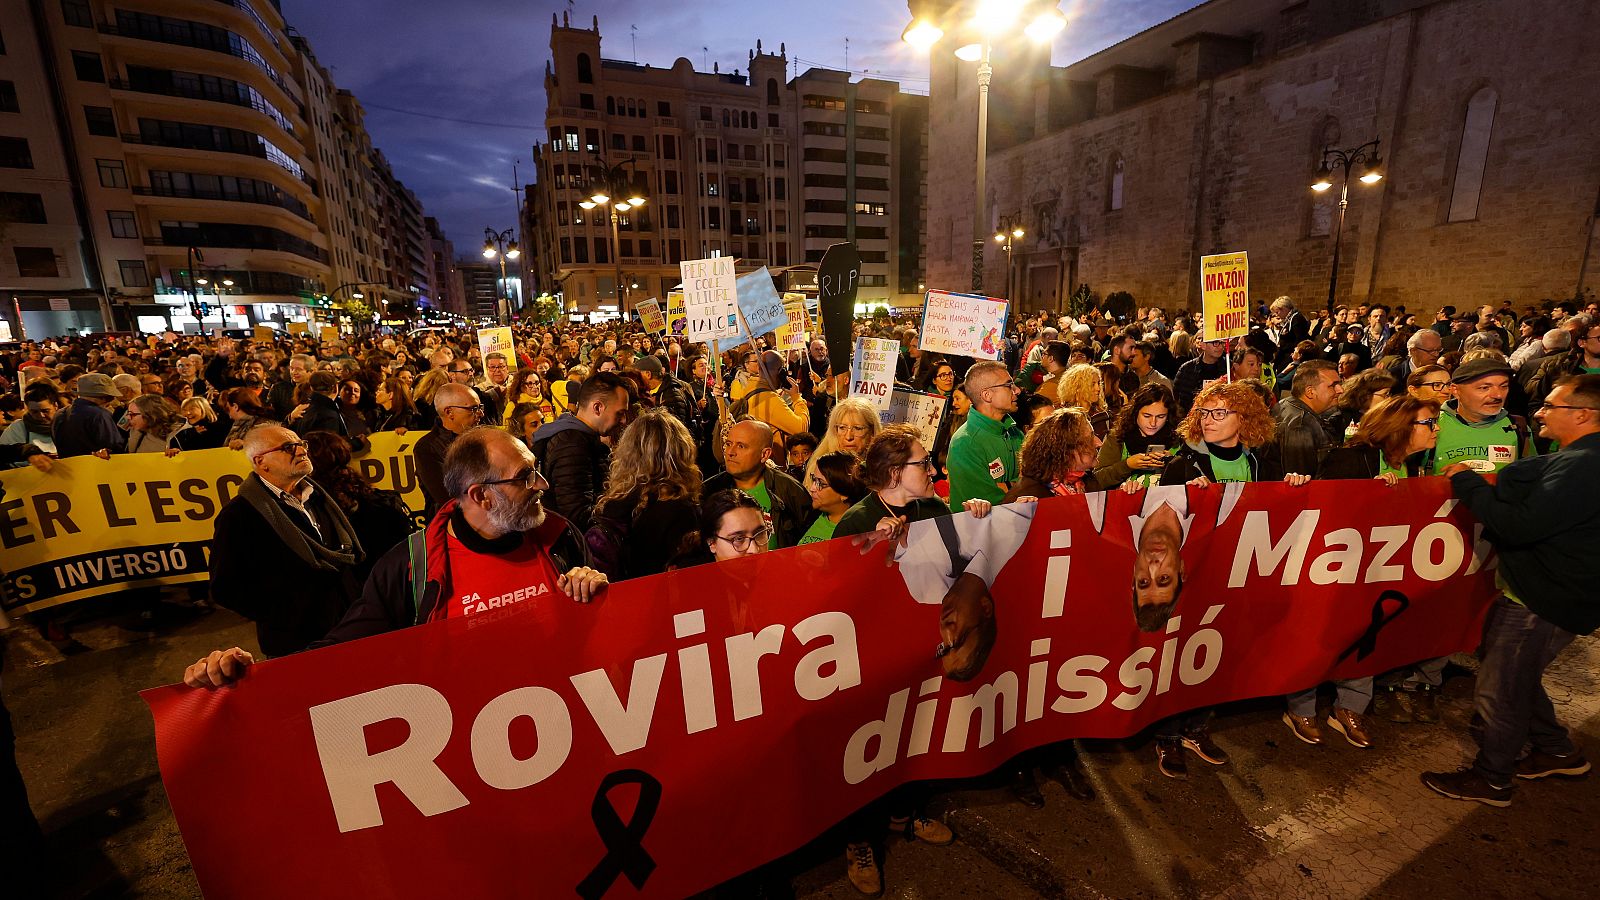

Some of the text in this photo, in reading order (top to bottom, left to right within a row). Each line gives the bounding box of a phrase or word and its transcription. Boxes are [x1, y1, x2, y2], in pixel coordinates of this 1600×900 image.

[683, 260, 730, 279] PER UN
[1205, 267, 1246, 291] MAZÓN
[1232, 290, 1246, 309] GO
[928, 311, 947, 321] HADA
[986, 305, 997, 316] LA
[925, 324, 967, 337] BASTA YA
[1215, 311, 1246, 332] HOME
[782, 334, 803, 345] HOME
[857, 338, 897, 352] PER UN
[925, 337, 936, 346] DE
[862, 351, 887, 361] COLE
[54, 542, 188, 590] INVERSIÓ
[463, 582, 549, 616] CARRERA
[309, 608, 862, 834] Rovira
[1040, 529, 1072, 619] i
[842, 604, 1226, 786] dimissió
